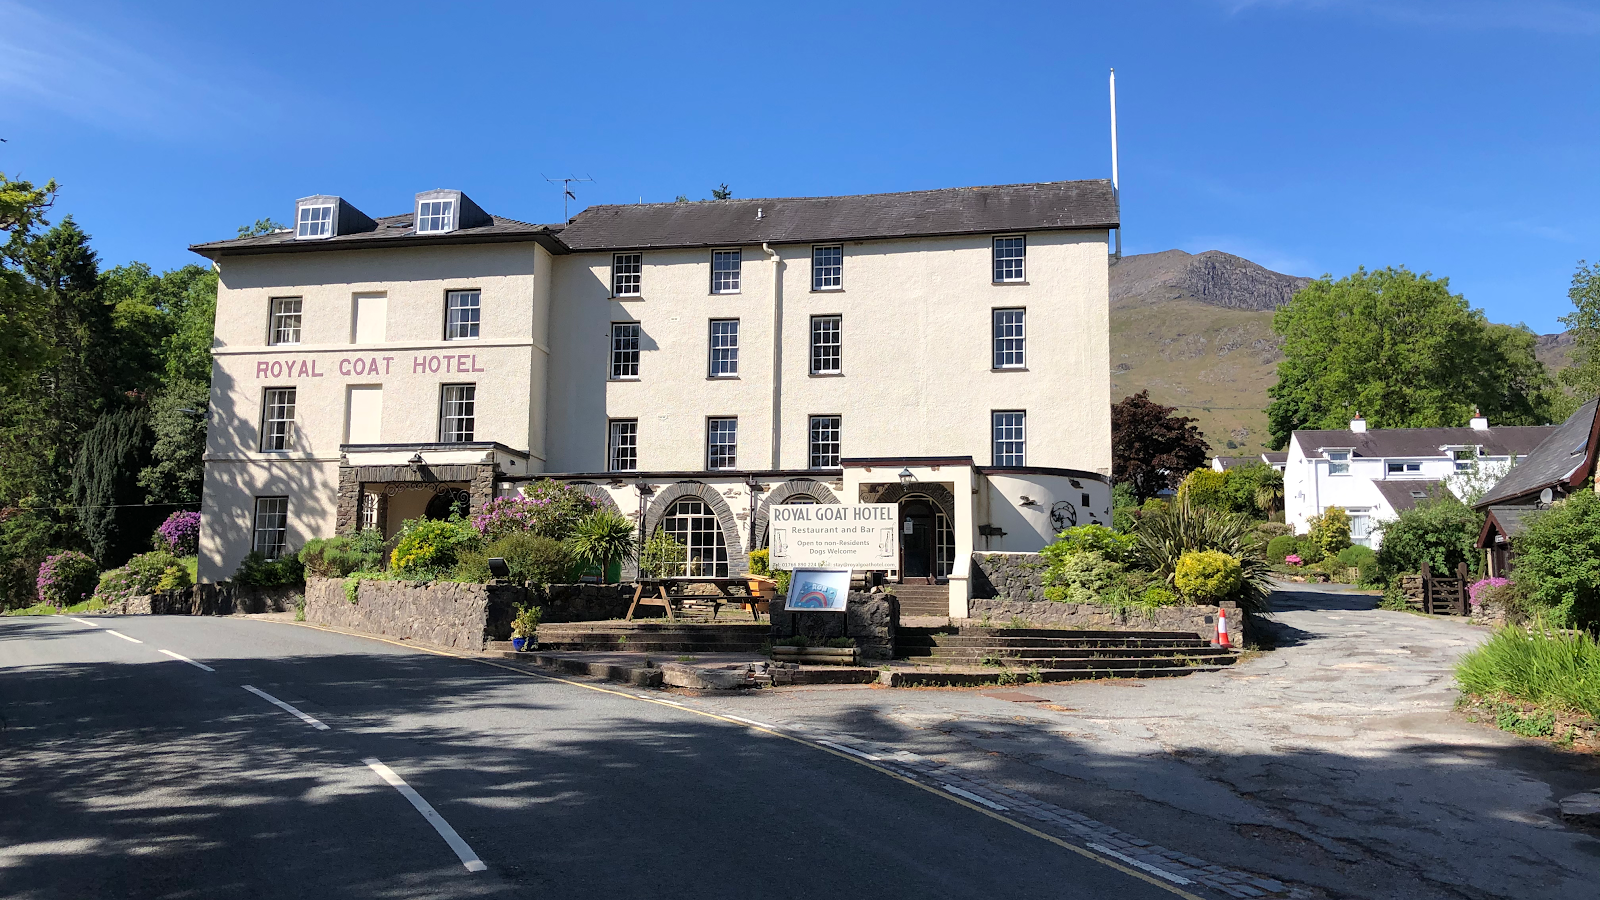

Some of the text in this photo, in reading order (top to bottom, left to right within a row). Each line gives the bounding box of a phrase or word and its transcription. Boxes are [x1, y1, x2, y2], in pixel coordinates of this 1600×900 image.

[255, 354, 485, 378] ROYAL GOAT HOTEL
[774, 506, 893, 521] ROYAL GOAT HOTEL
[791, 526, 839, 534] Restaurant
